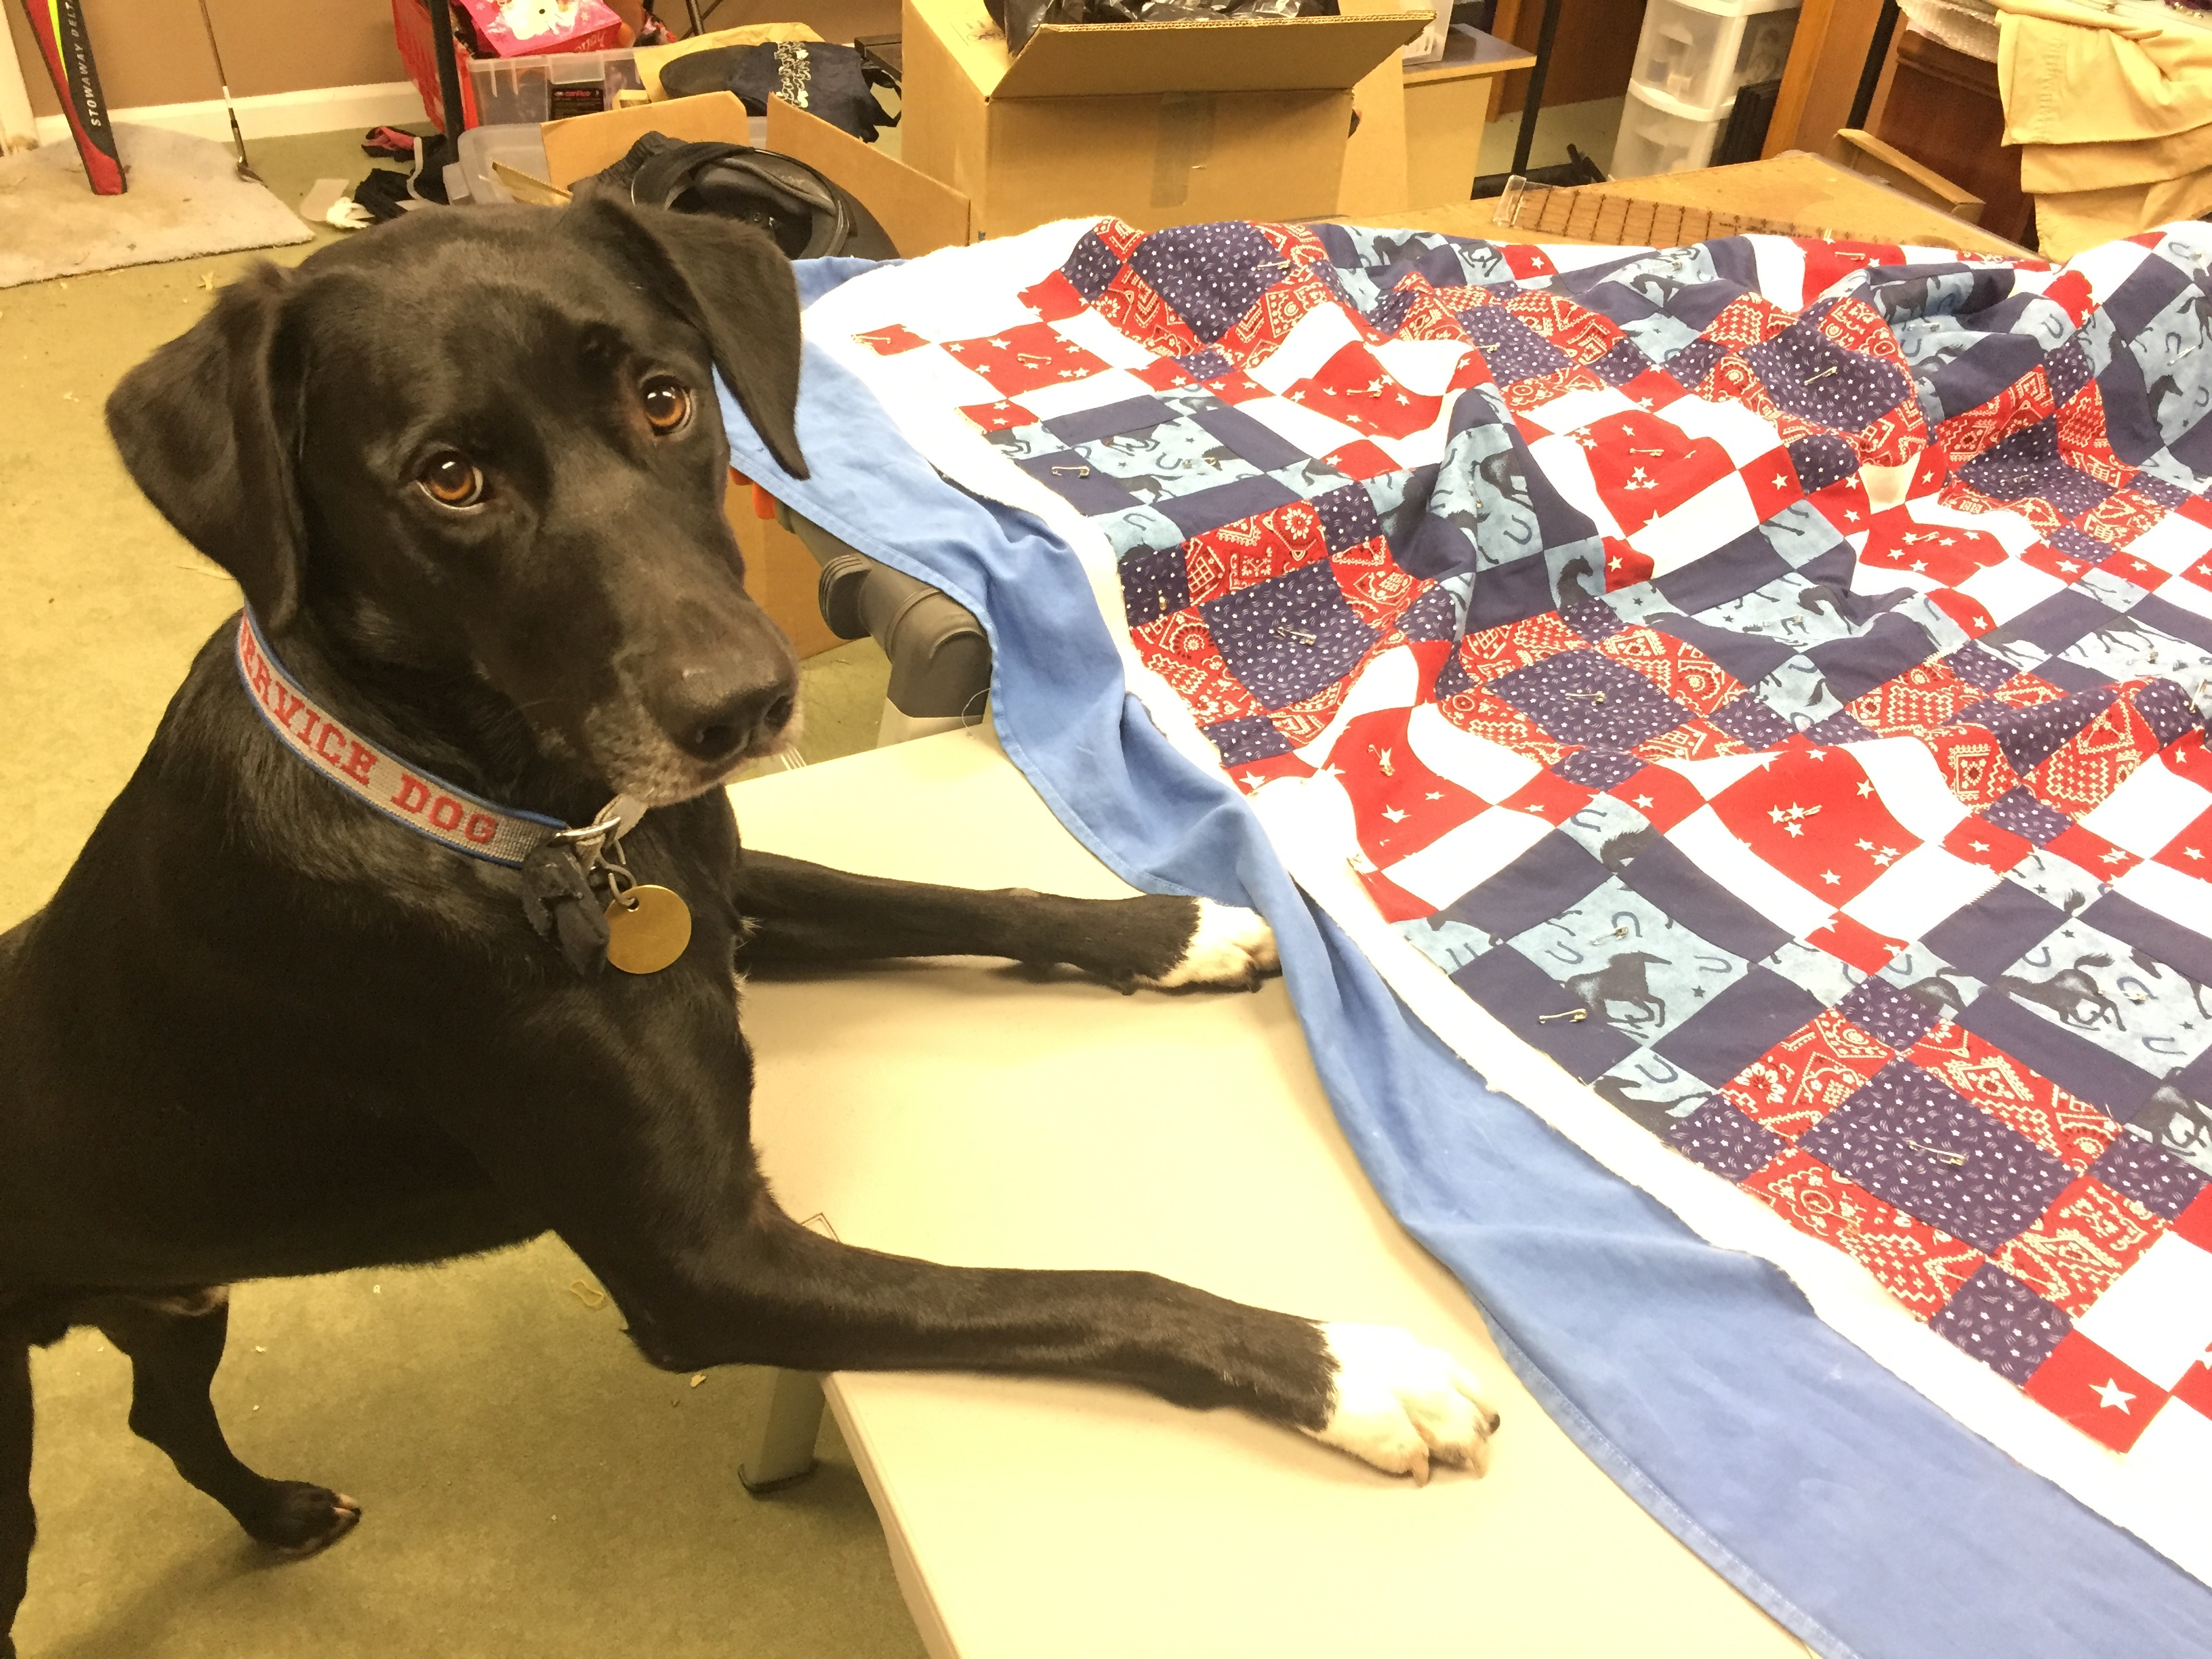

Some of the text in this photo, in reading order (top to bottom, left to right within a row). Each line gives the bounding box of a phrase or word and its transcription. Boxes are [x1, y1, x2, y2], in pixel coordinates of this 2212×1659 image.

[65, 0, 102, 127] STOWAWAY DELT
[390, 773, 497, 844] DOG
